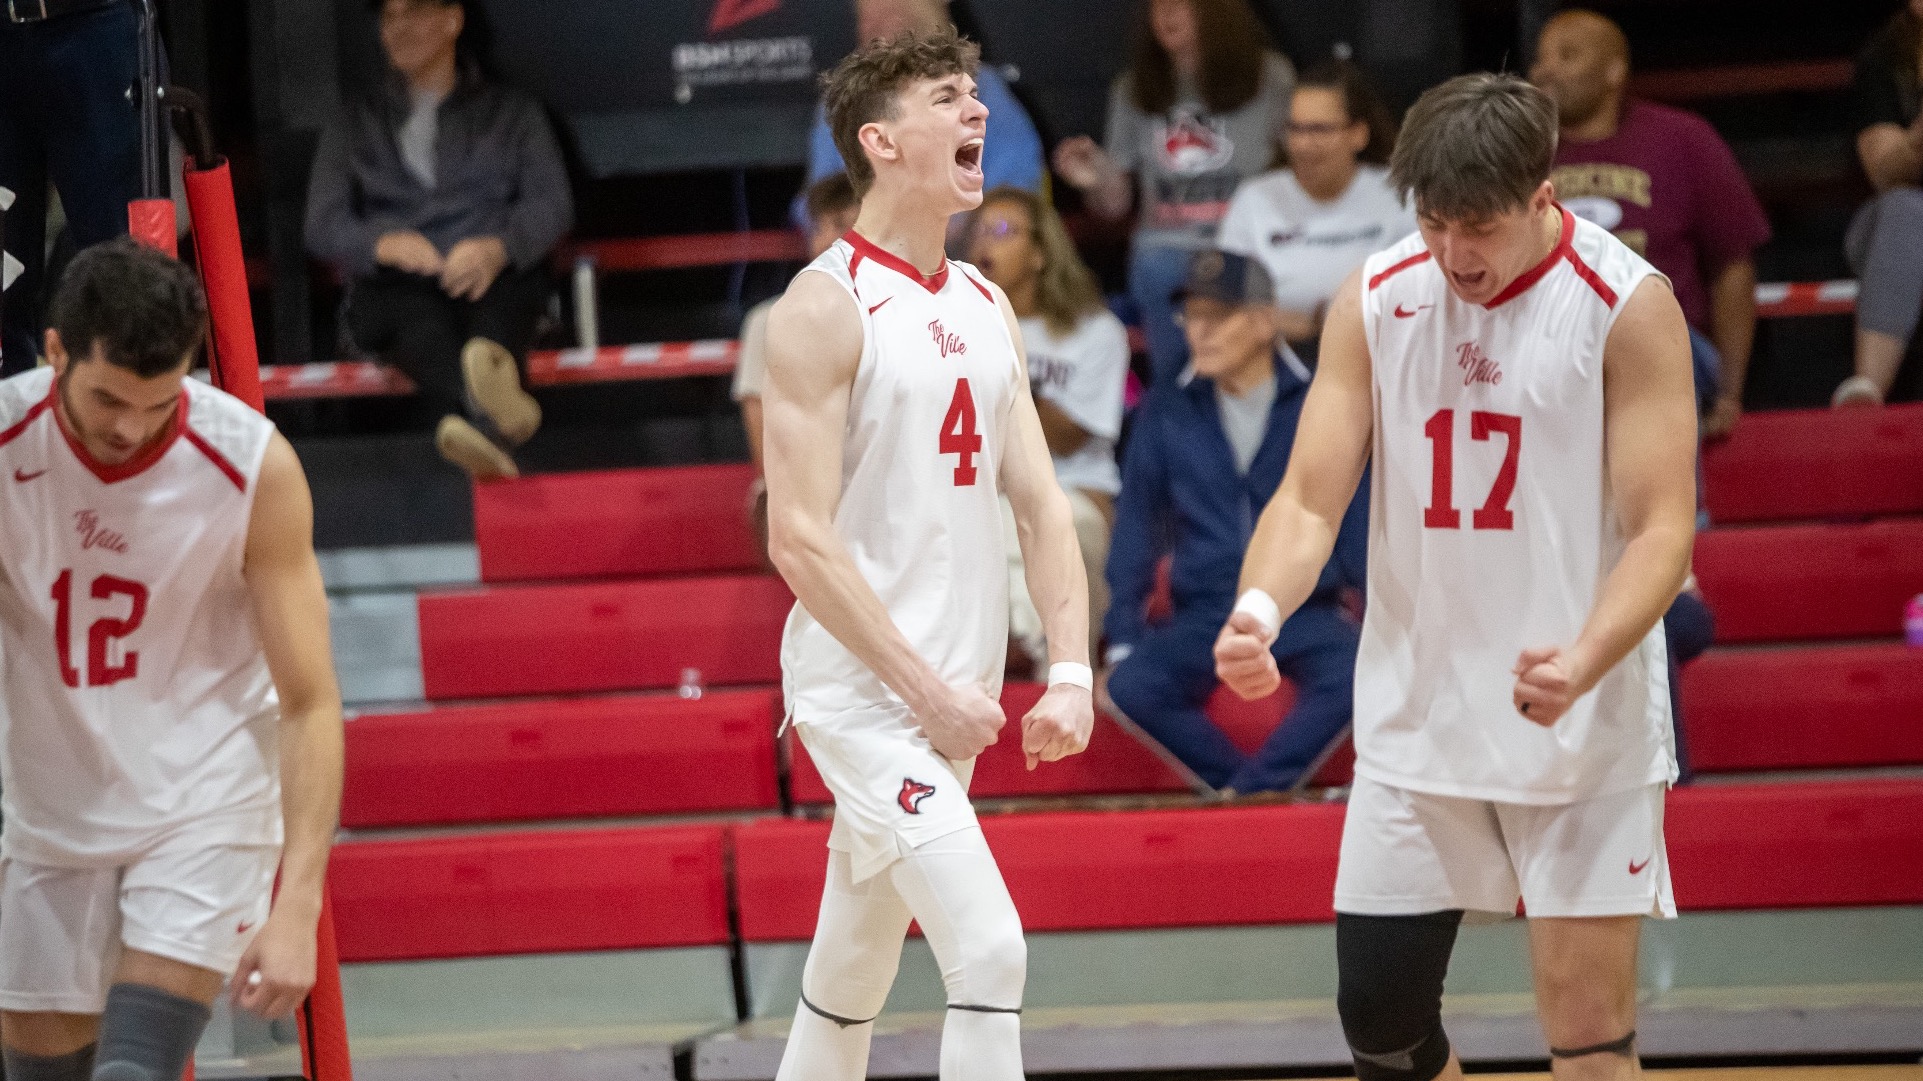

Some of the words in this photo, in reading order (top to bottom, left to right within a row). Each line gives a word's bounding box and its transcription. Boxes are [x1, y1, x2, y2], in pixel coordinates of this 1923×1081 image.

[928, 319, 944, 341] The
[1456, 341, 1481, 369] The
[1464, 357, 1503, 386] Ville
[939, 377, 982, 486] 4
[1424, 408, 1522, 530] 17
[82, 527, 129, 554] Ville
[51, 567, 149, 688] 12
